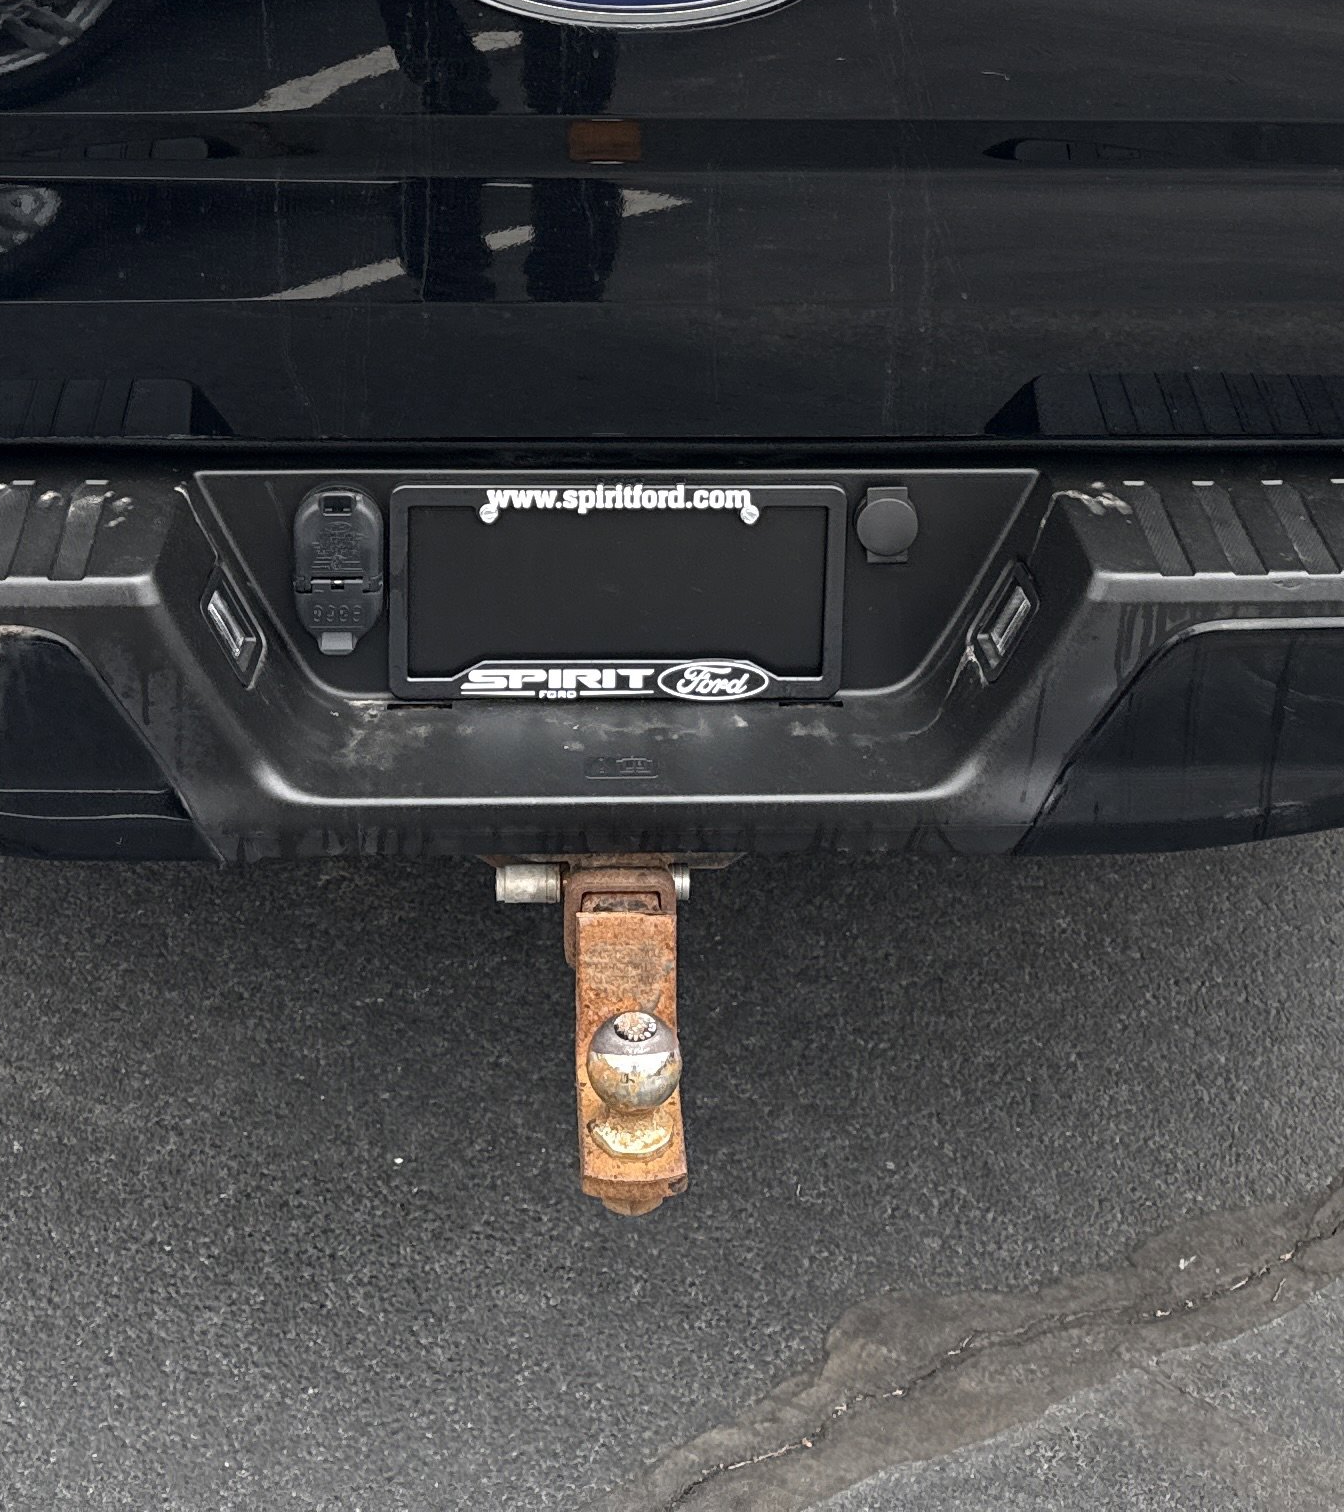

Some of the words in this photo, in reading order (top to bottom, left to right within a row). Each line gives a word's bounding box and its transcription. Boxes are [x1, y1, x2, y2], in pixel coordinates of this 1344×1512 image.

[486, 483, 752, 514] www.spiritford.com
[460, 668, 655, 689] SPIRIT
[676, 665, 750, 696] Ford
[539, 689, 577, 699] FORD
